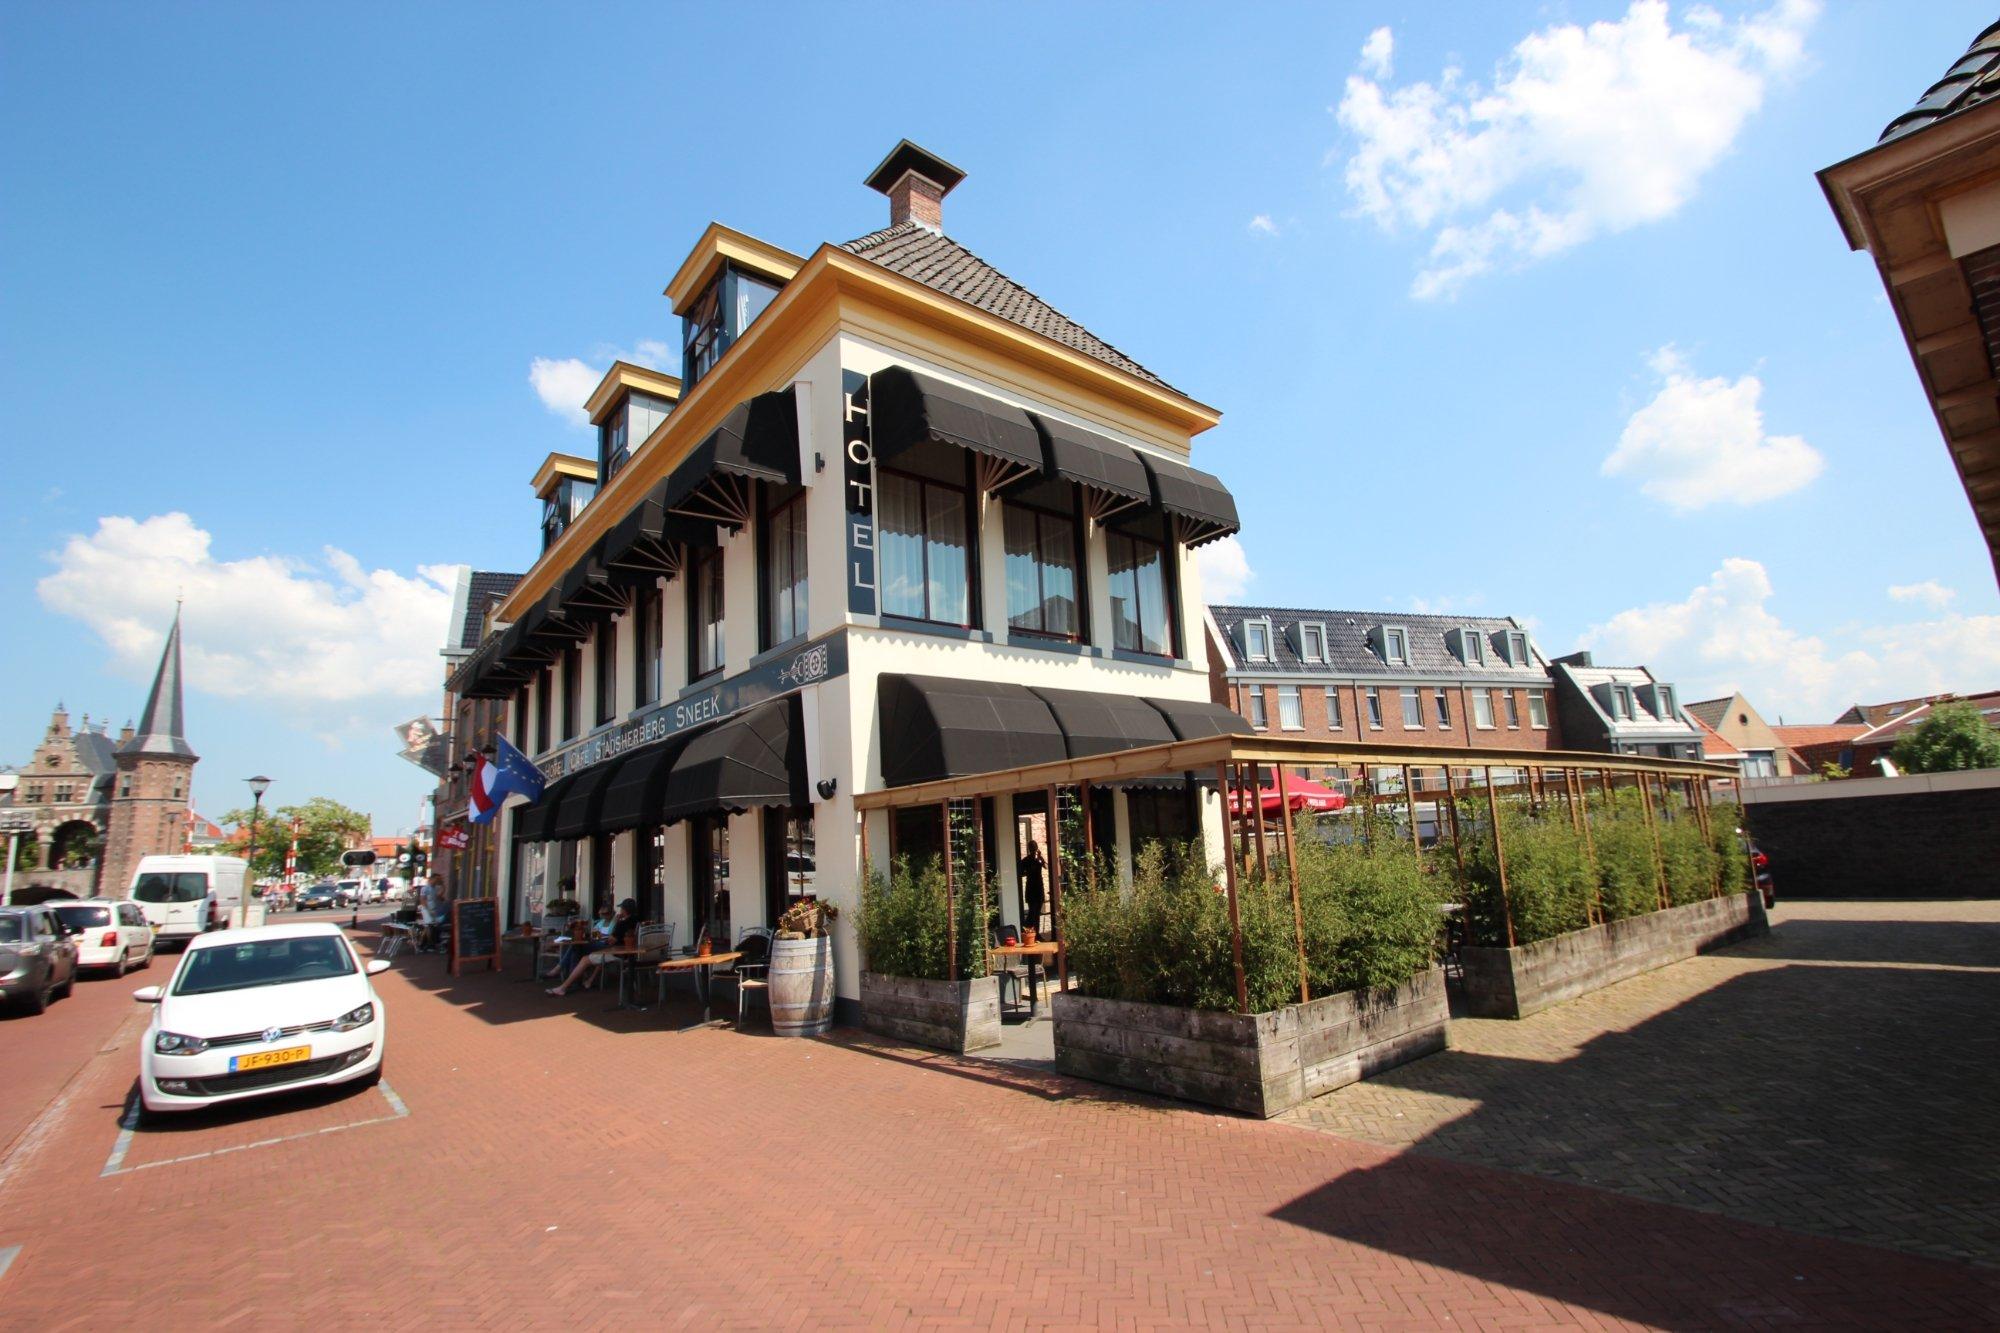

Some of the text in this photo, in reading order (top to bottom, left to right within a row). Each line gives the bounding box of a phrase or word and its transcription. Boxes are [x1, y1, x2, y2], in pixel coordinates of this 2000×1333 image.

[845, 392, 875, 589] HOTEL
[595, 717, 666, 760] STADSHERBERG
[676, 694, 720, 728] SNEEK
[243, 1049, 304, 1068] JF-930-P
